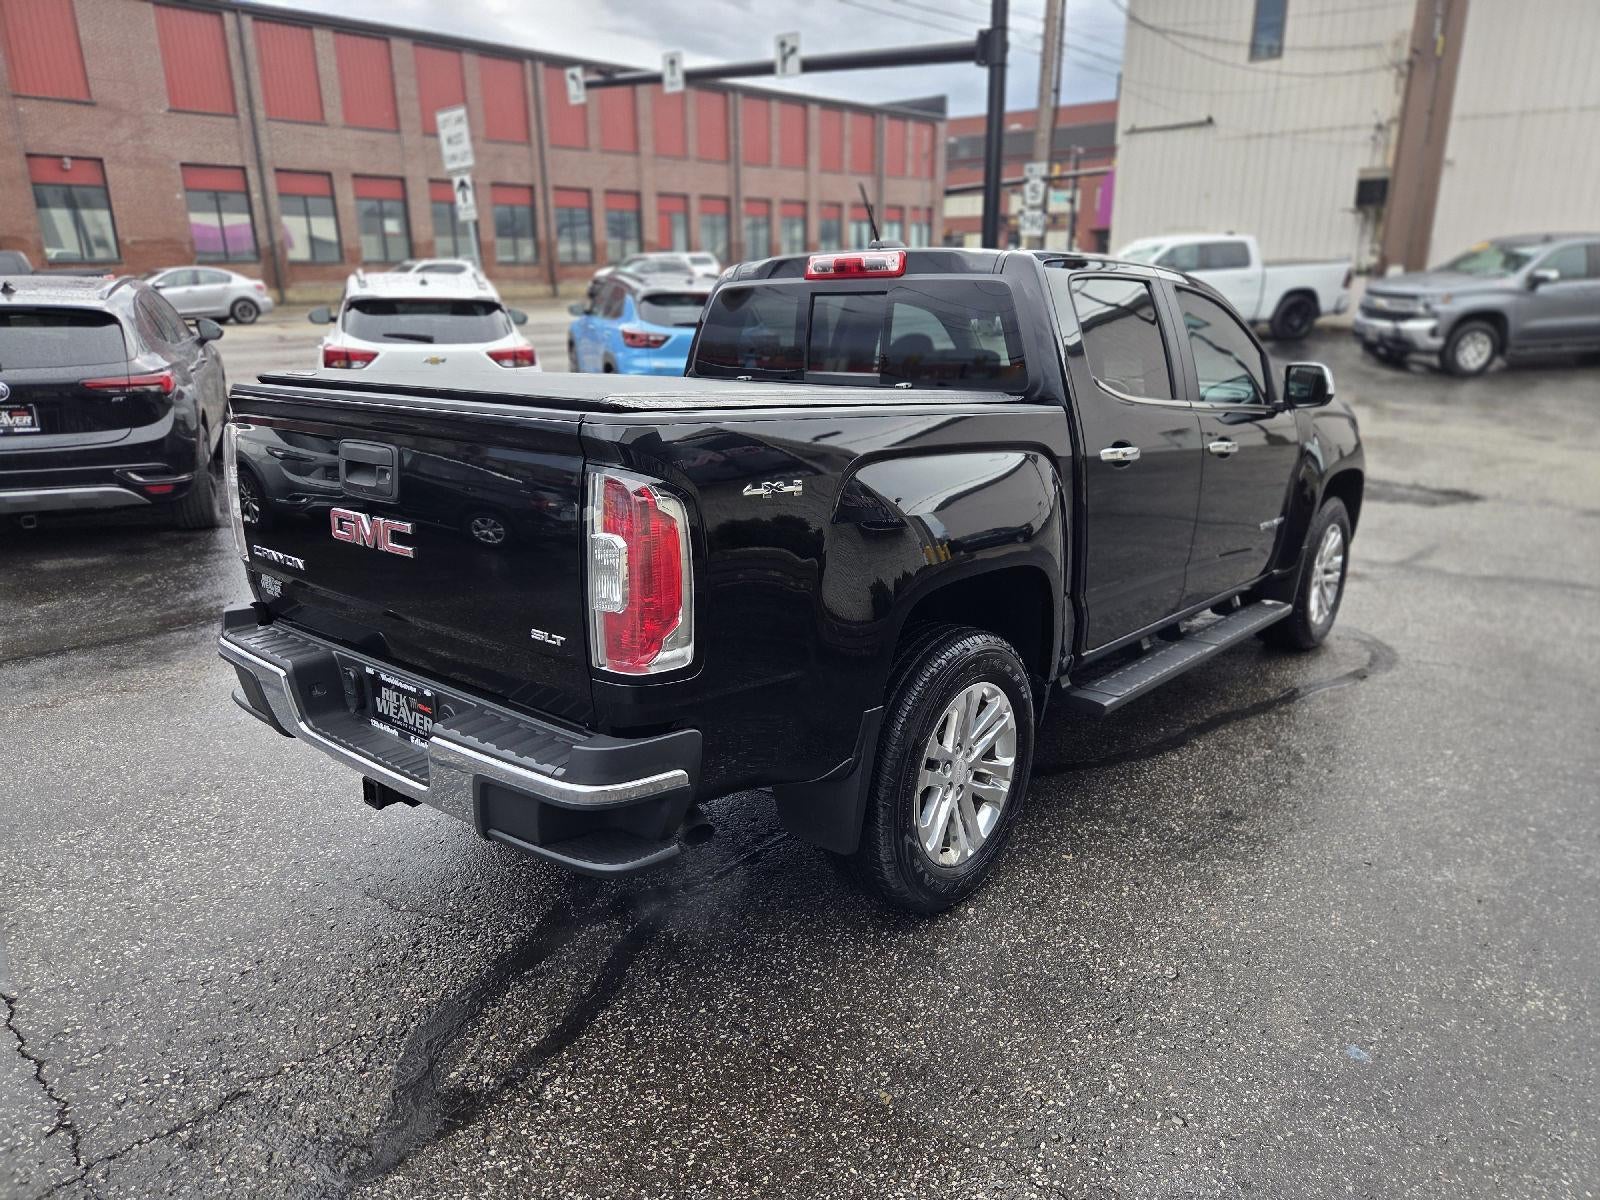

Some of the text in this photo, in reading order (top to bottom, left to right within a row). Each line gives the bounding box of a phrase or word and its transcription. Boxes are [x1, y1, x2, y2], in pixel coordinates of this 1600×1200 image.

[329, 507, 417, 559] GMC
[253, 544, 305, 571] CANYON
[530, 628, 566, 647] SLT
[381, 686, 407, 707] RICK
[375, 696, 433, 734] WEAVER
